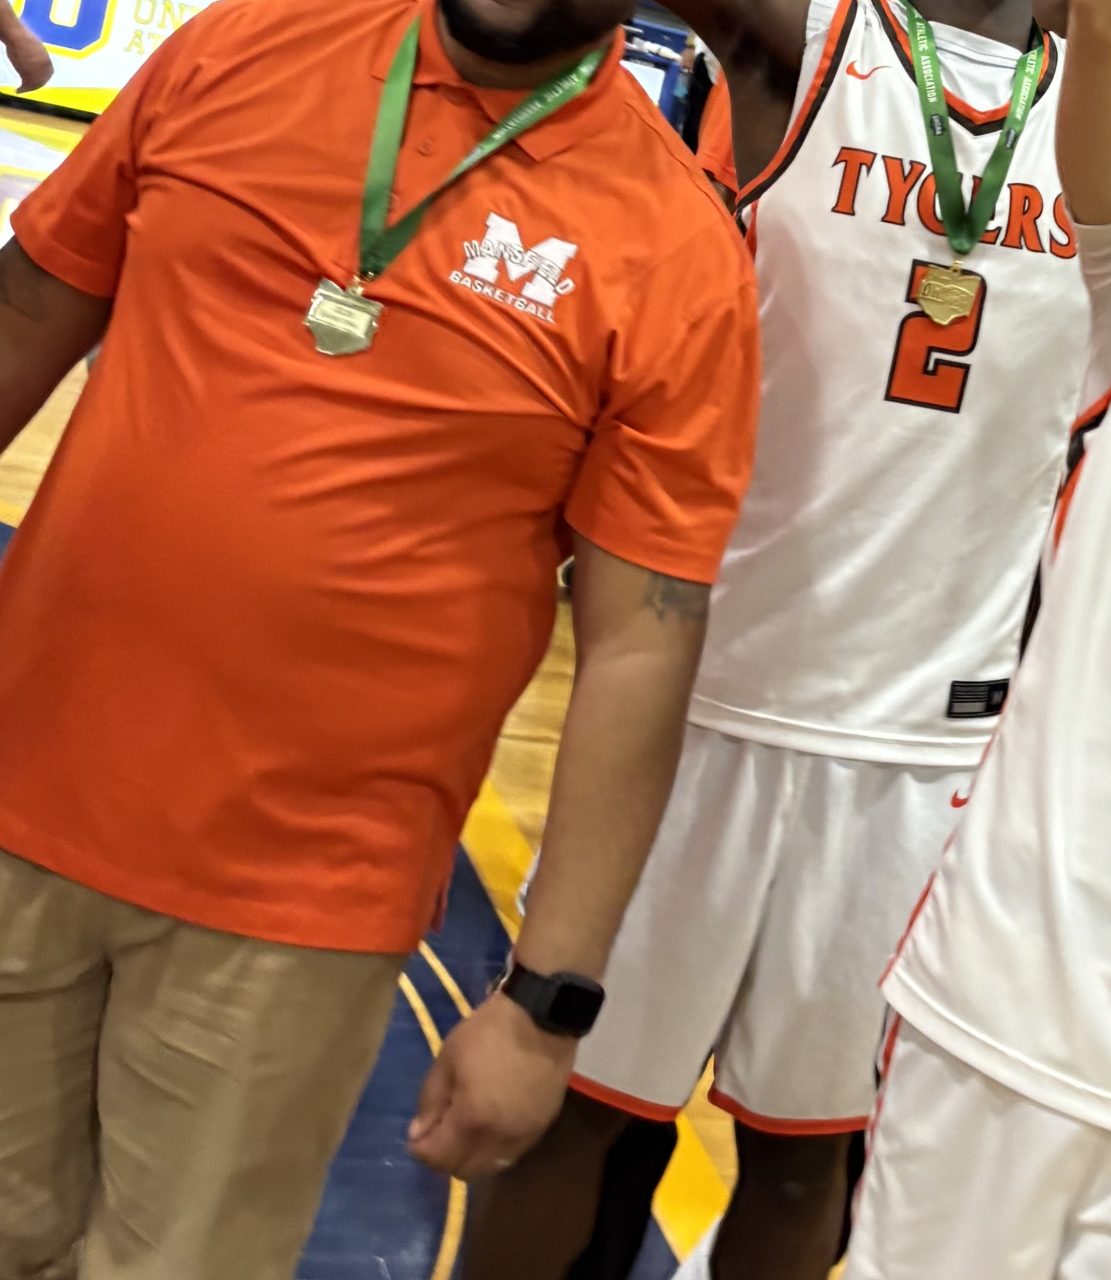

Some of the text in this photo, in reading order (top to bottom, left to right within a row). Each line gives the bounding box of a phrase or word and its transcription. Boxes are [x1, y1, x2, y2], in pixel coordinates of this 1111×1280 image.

[920, 55, 938, 103] ASSOCIATION
[449, 270, 557, 324] BASKETBALL
[884, 258, 988, 414] 2
